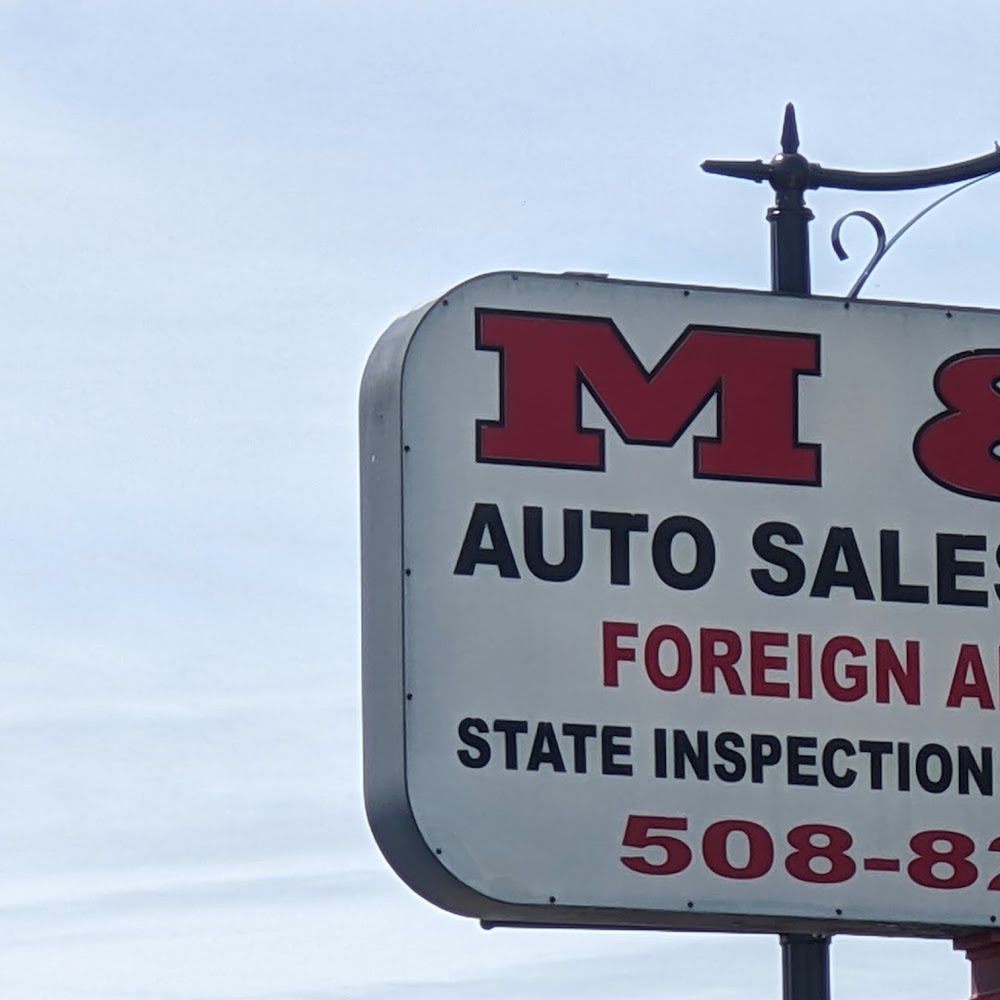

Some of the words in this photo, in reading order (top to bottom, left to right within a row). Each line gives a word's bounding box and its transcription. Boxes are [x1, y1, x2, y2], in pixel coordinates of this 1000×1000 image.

[475, 307, 822, 488] M
[453, 502, 717, 591] AUTO
[602, 620, 921, 707] FOREIGN
[456, 717, 634, 777] STATE
[653, 727, 994, 798] INSPECTION
